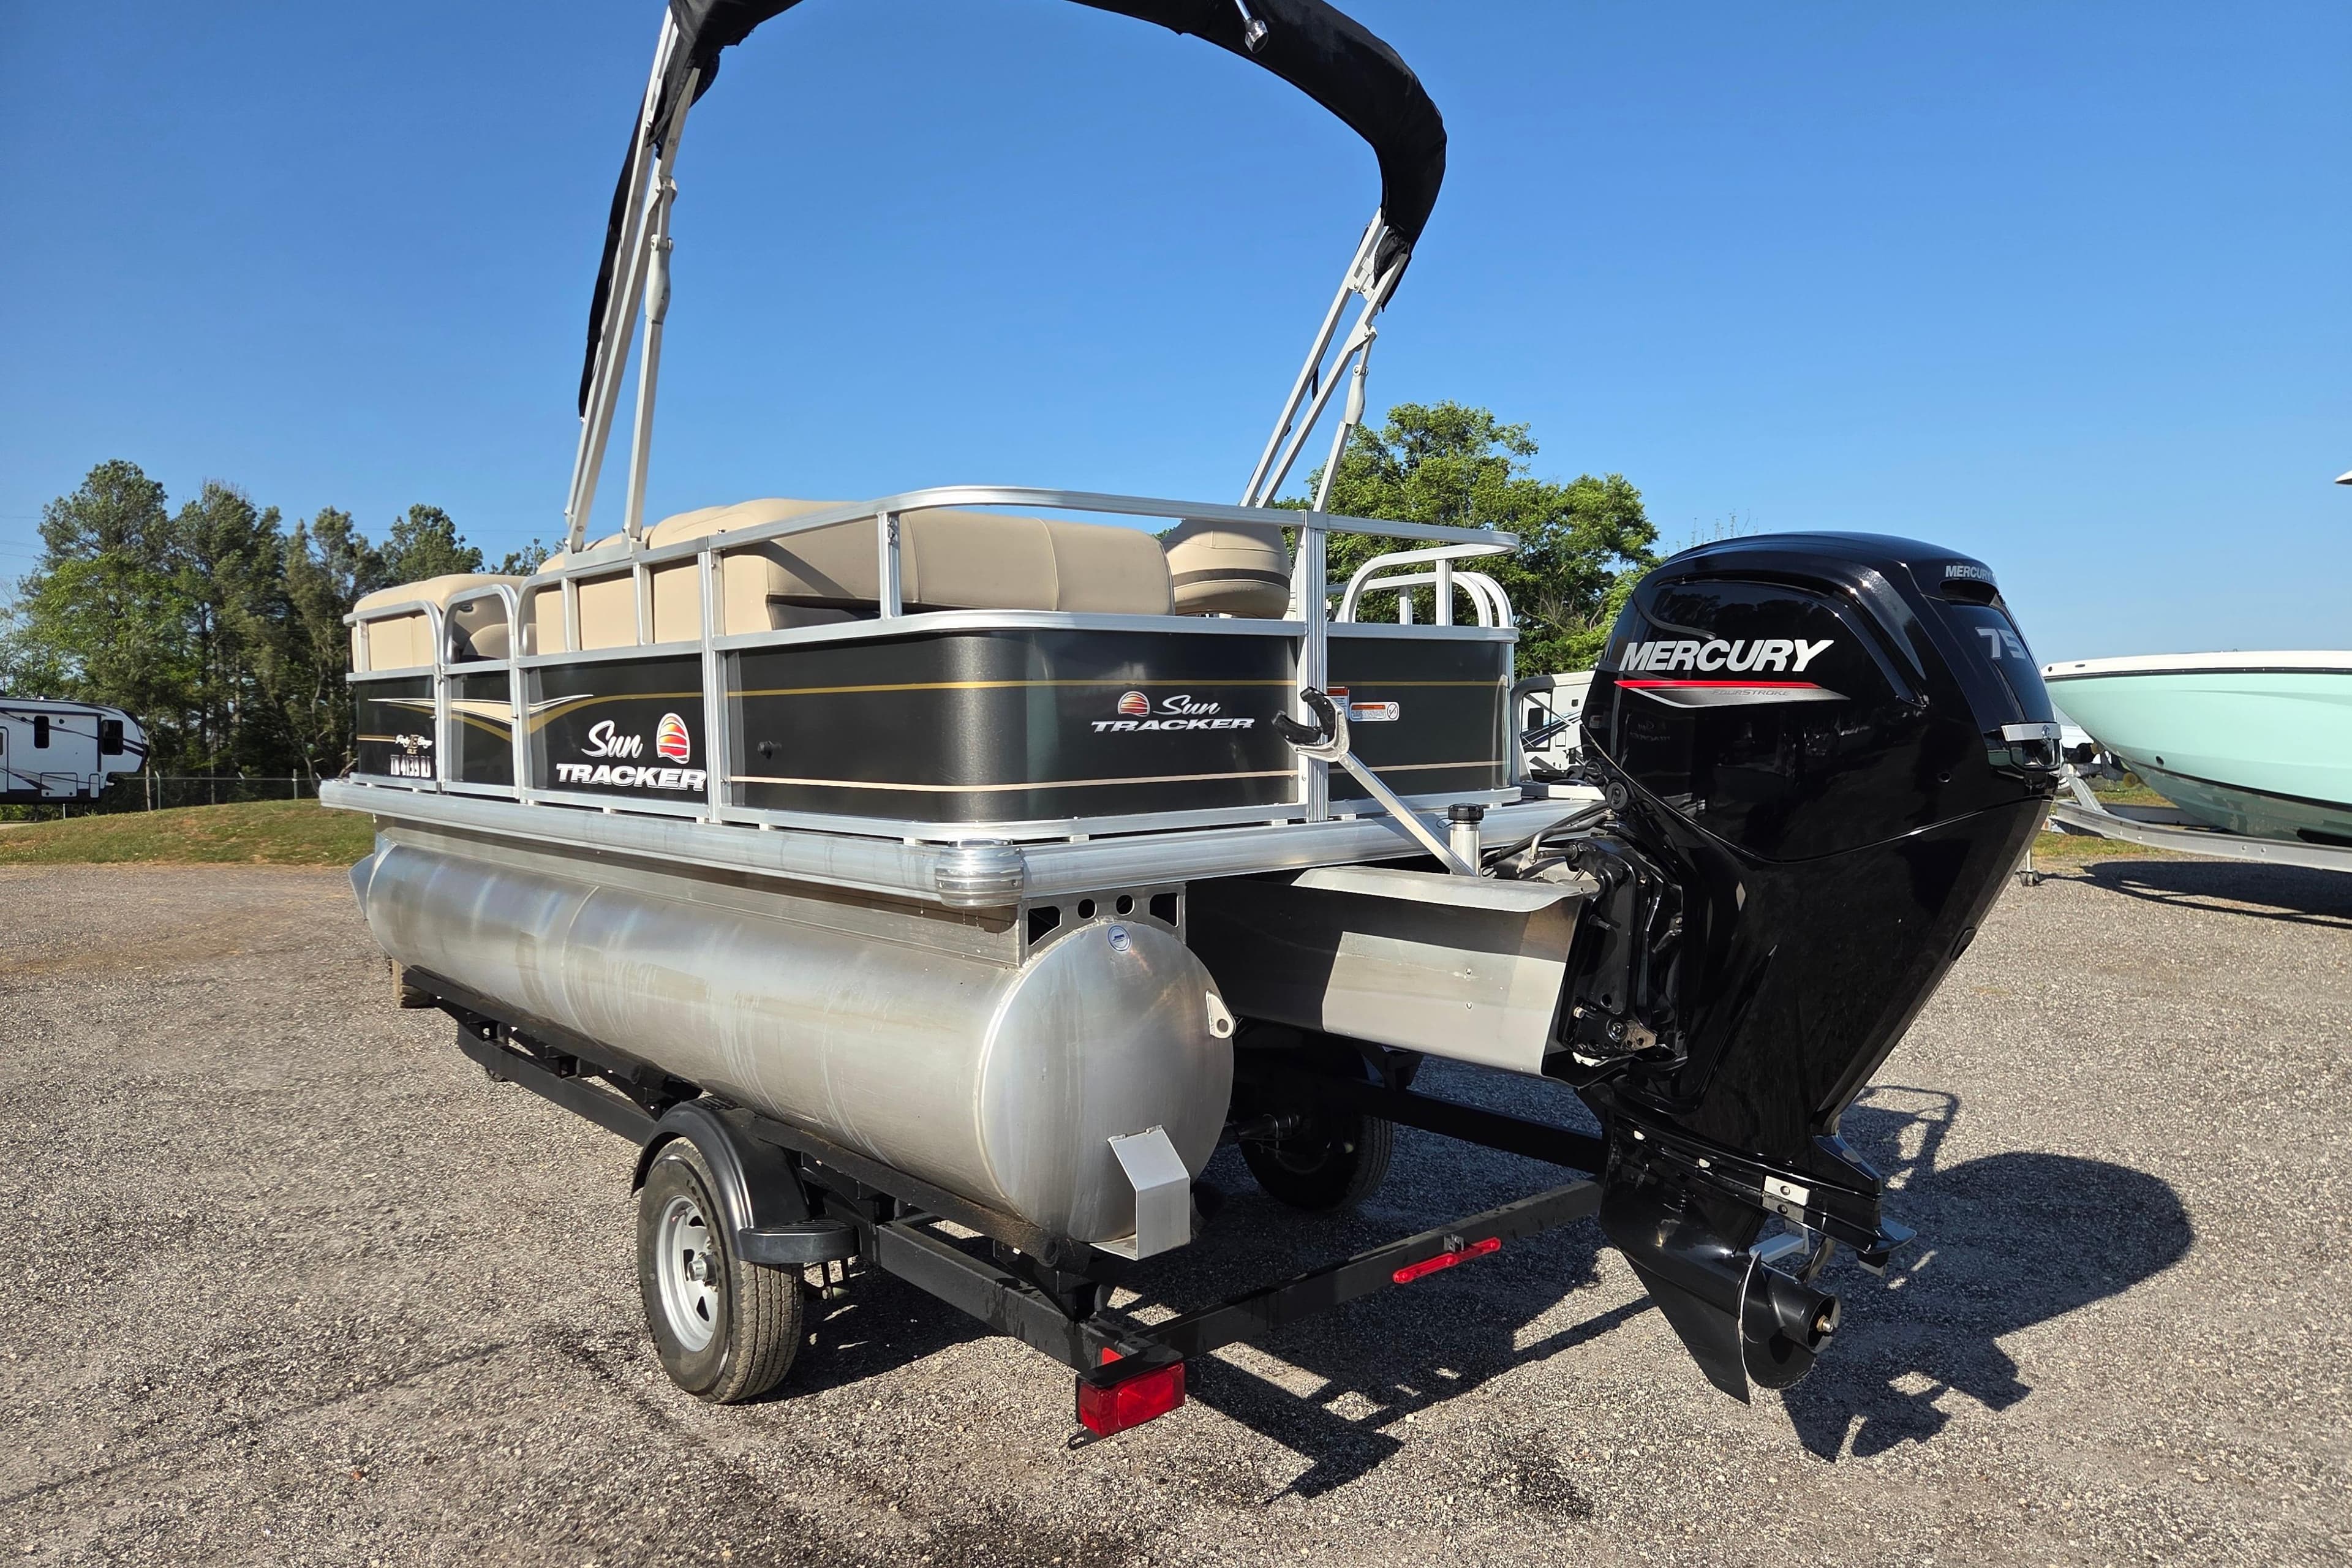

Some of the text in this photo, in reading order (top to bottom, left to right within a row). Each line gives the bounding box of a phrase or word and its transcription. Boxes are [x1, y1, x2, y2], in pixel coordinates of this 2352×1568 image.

[1945, 565, 1991, 581] MERCURY
[1618, 639, 1835, 673] MERCURY
[1975, 627, 2026, 660] 75
[1153, 694, 1221, 716] Sun
[1091, 717, 1255, 733] TRACKER
[581, 720, 643, 759] Sun
[556, 763, 707, 791] TRACKER
